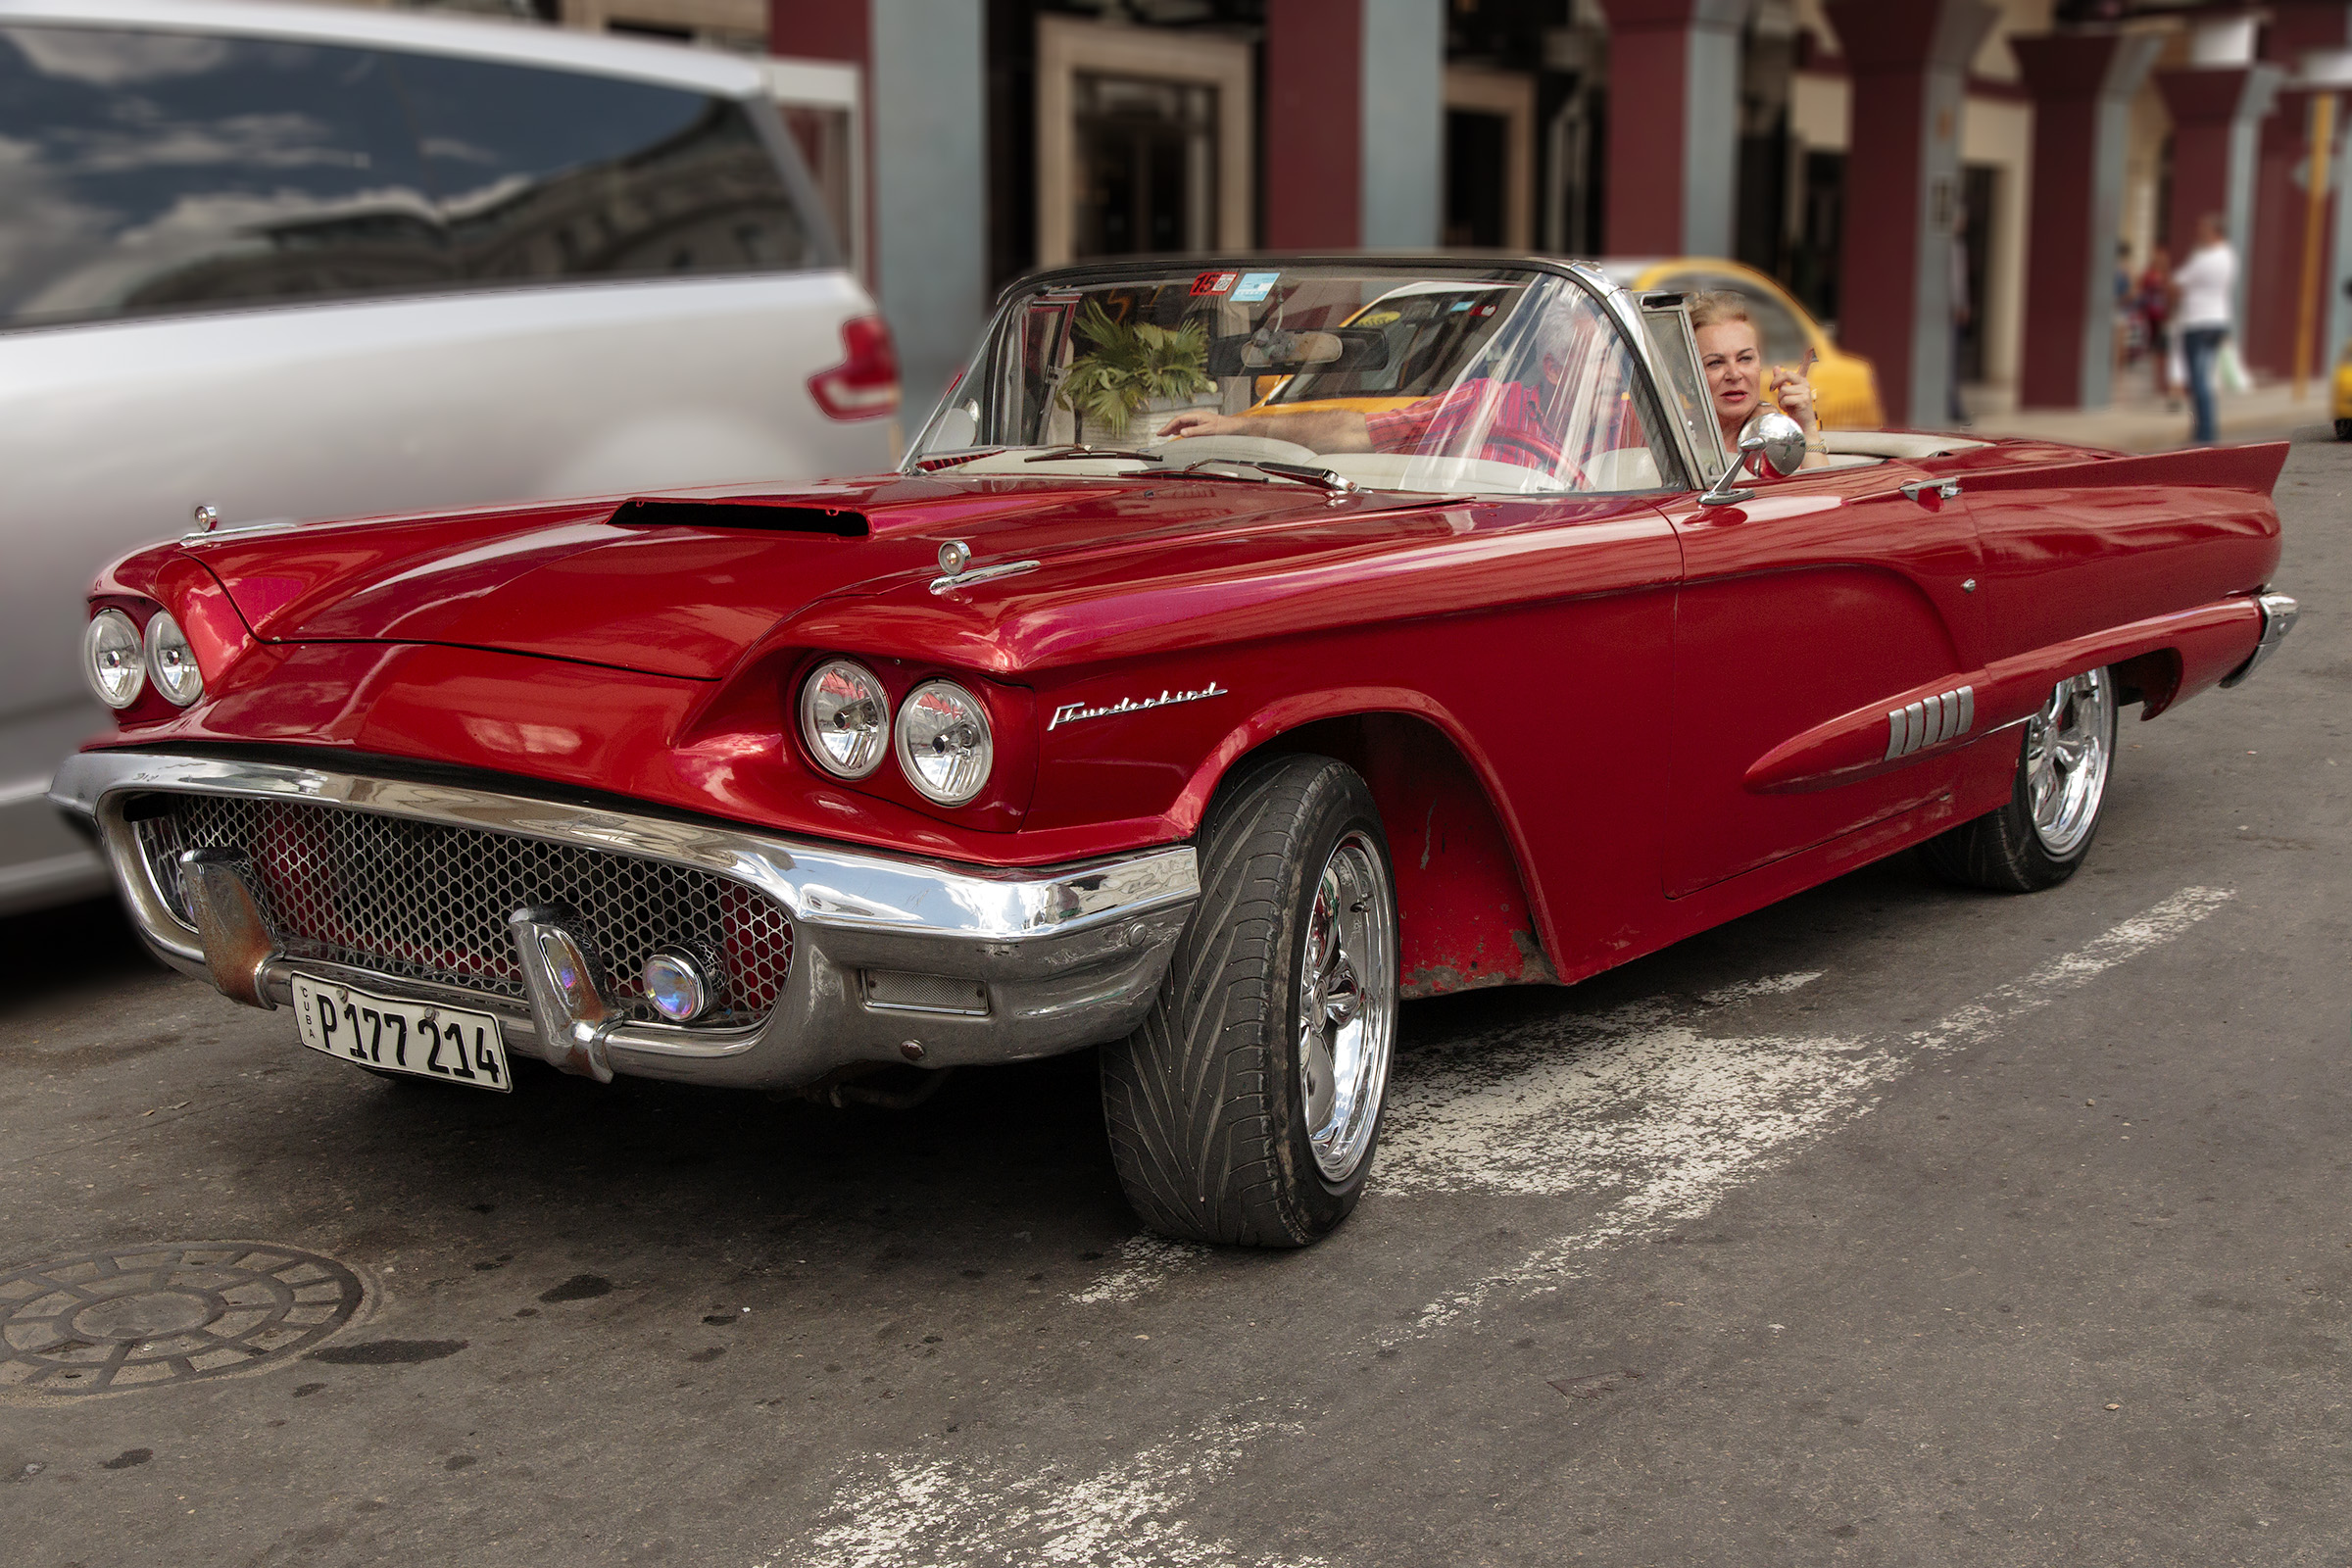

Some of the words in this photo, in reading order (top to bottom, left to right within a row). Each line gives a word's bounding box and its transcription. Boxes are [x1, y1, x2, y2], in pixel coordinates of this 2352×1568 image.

[1047, 681, 1228, 731] Thunderbird
[301, 987, 316, 1039] CUBA
[416, 1017, 501, 1083] 214
